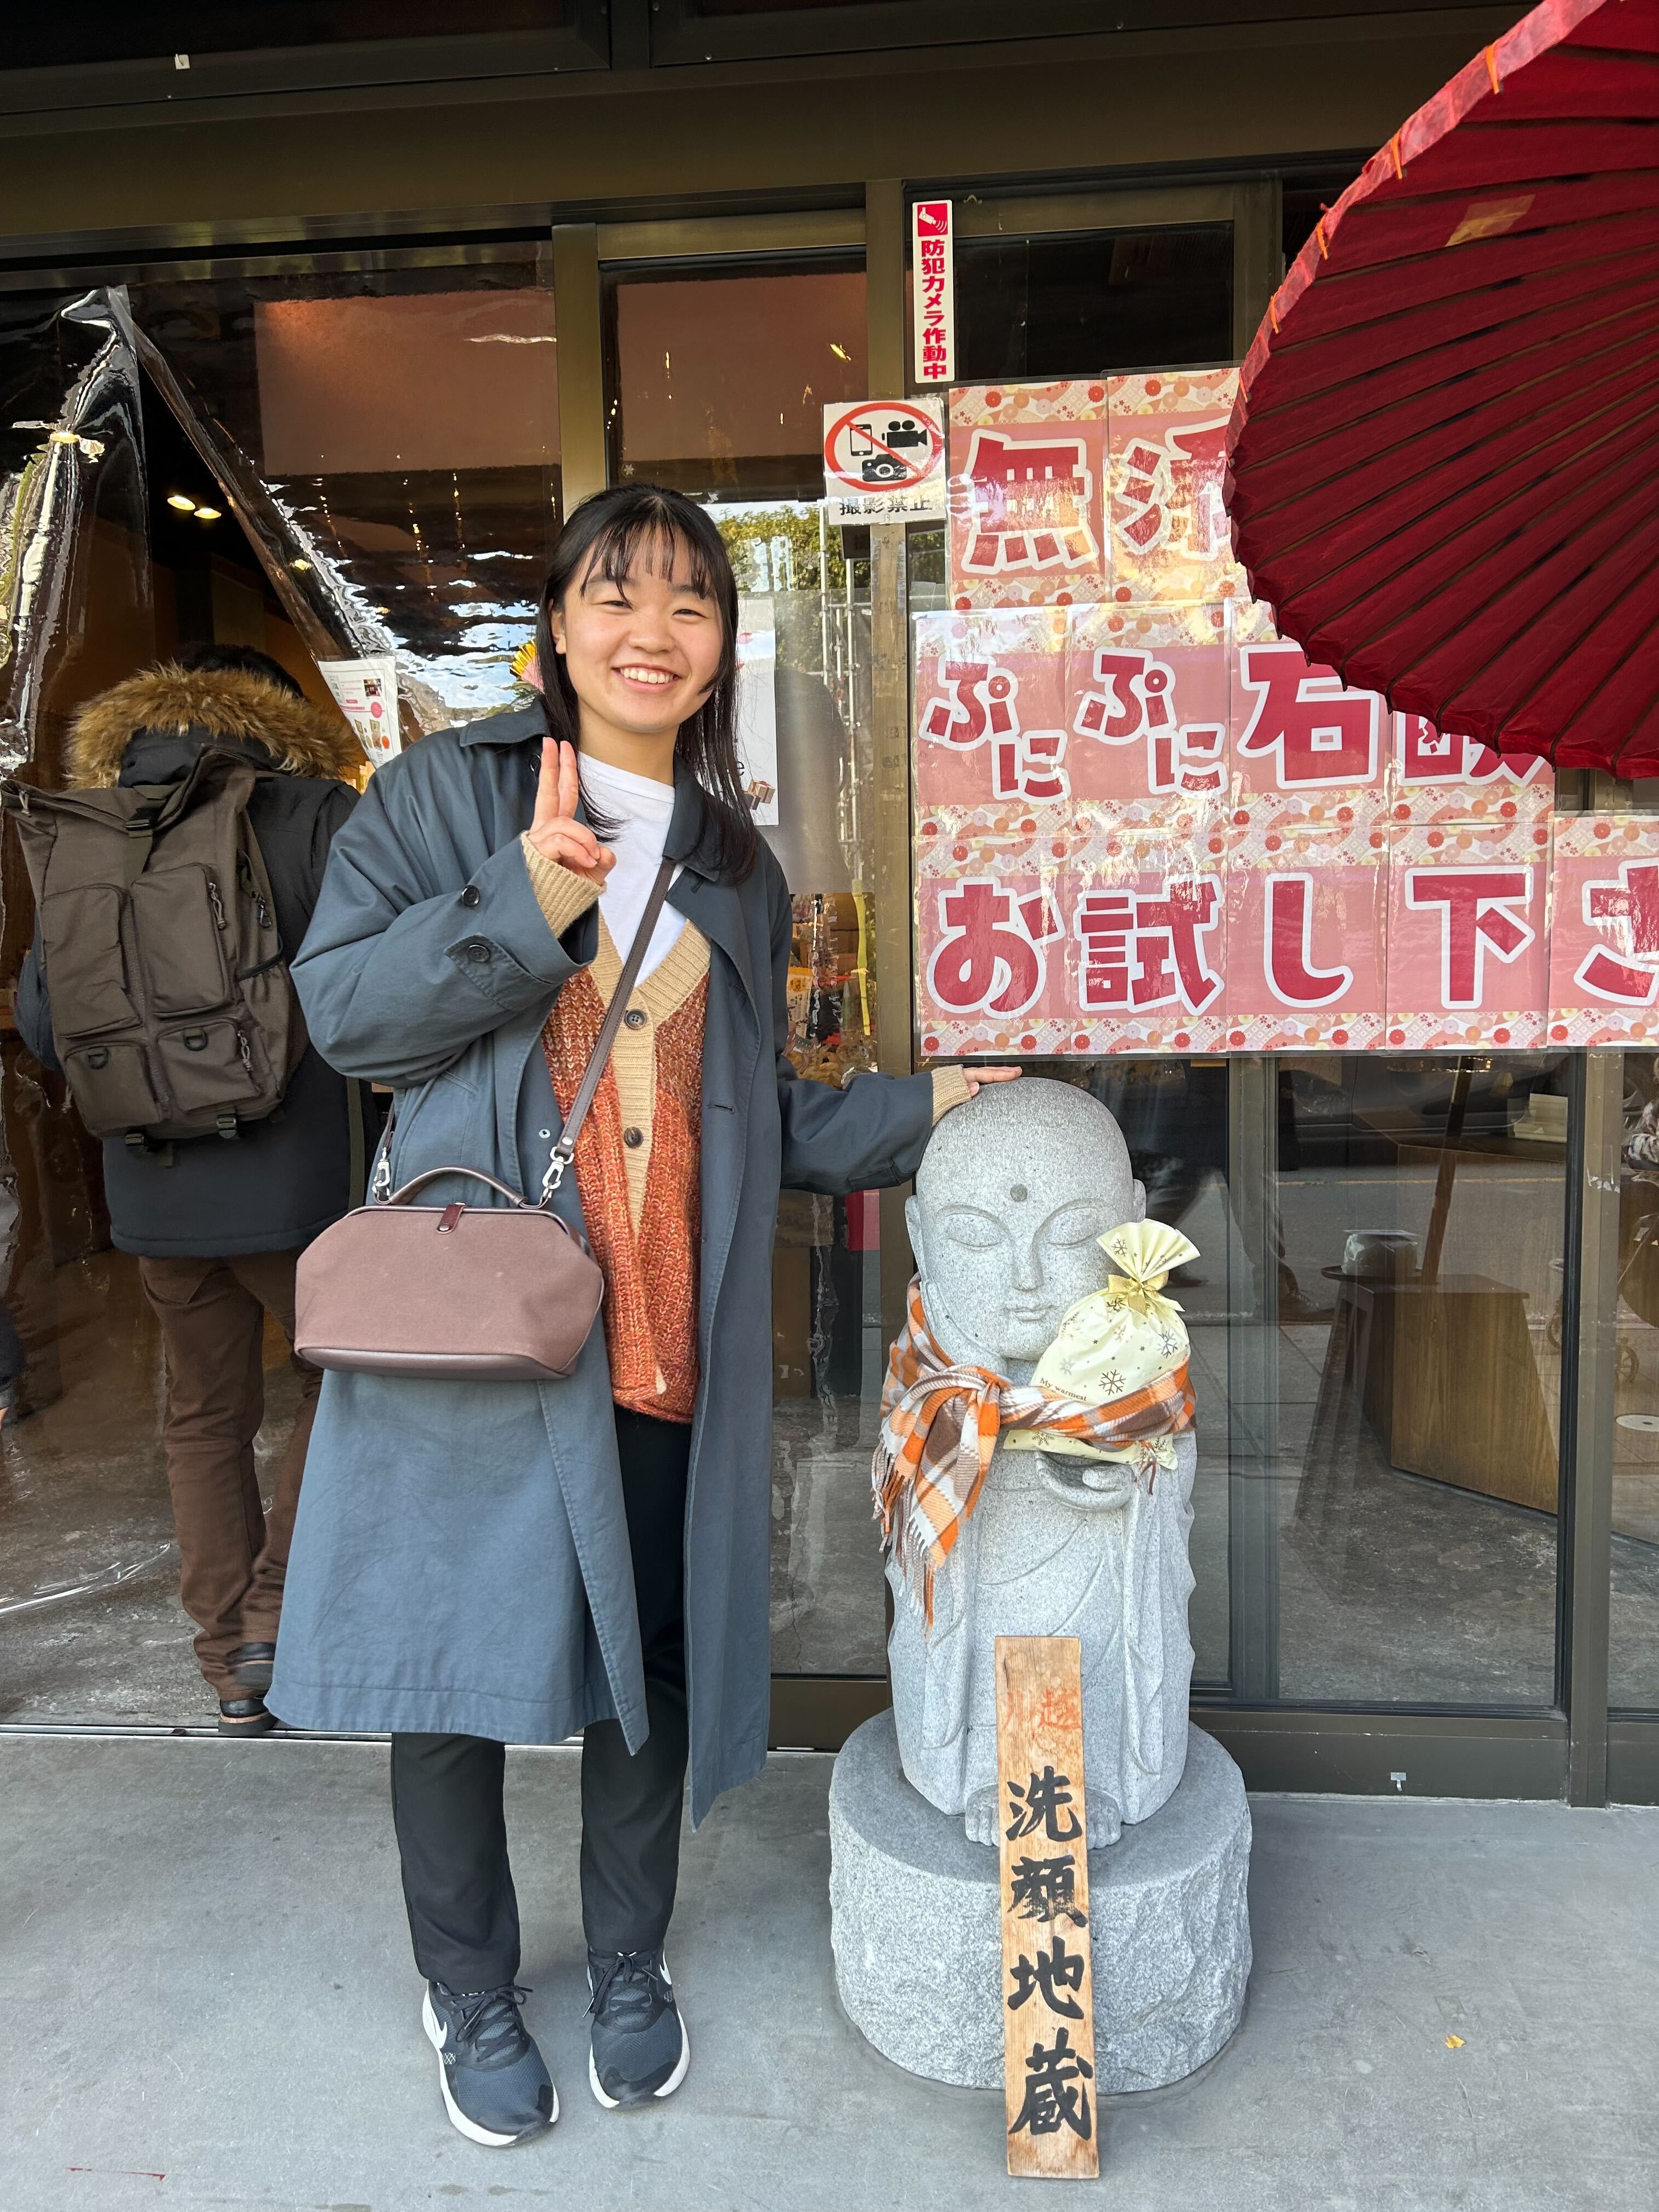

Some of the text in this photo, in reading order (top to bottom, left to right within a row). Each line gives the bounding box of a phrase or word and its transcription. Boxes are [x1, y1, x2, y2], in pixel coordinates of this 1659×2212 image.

[921, 239, 947, 380] 防犯カメラ作動中
[840, 495, 933, 515] 撮影禁止
[930, 860, 1659, 1016] お試し下さ
[1040, 1378, 1087, 1401] My warmest
[1006, 1765, 1093, 2140] 洗顔地蔵
